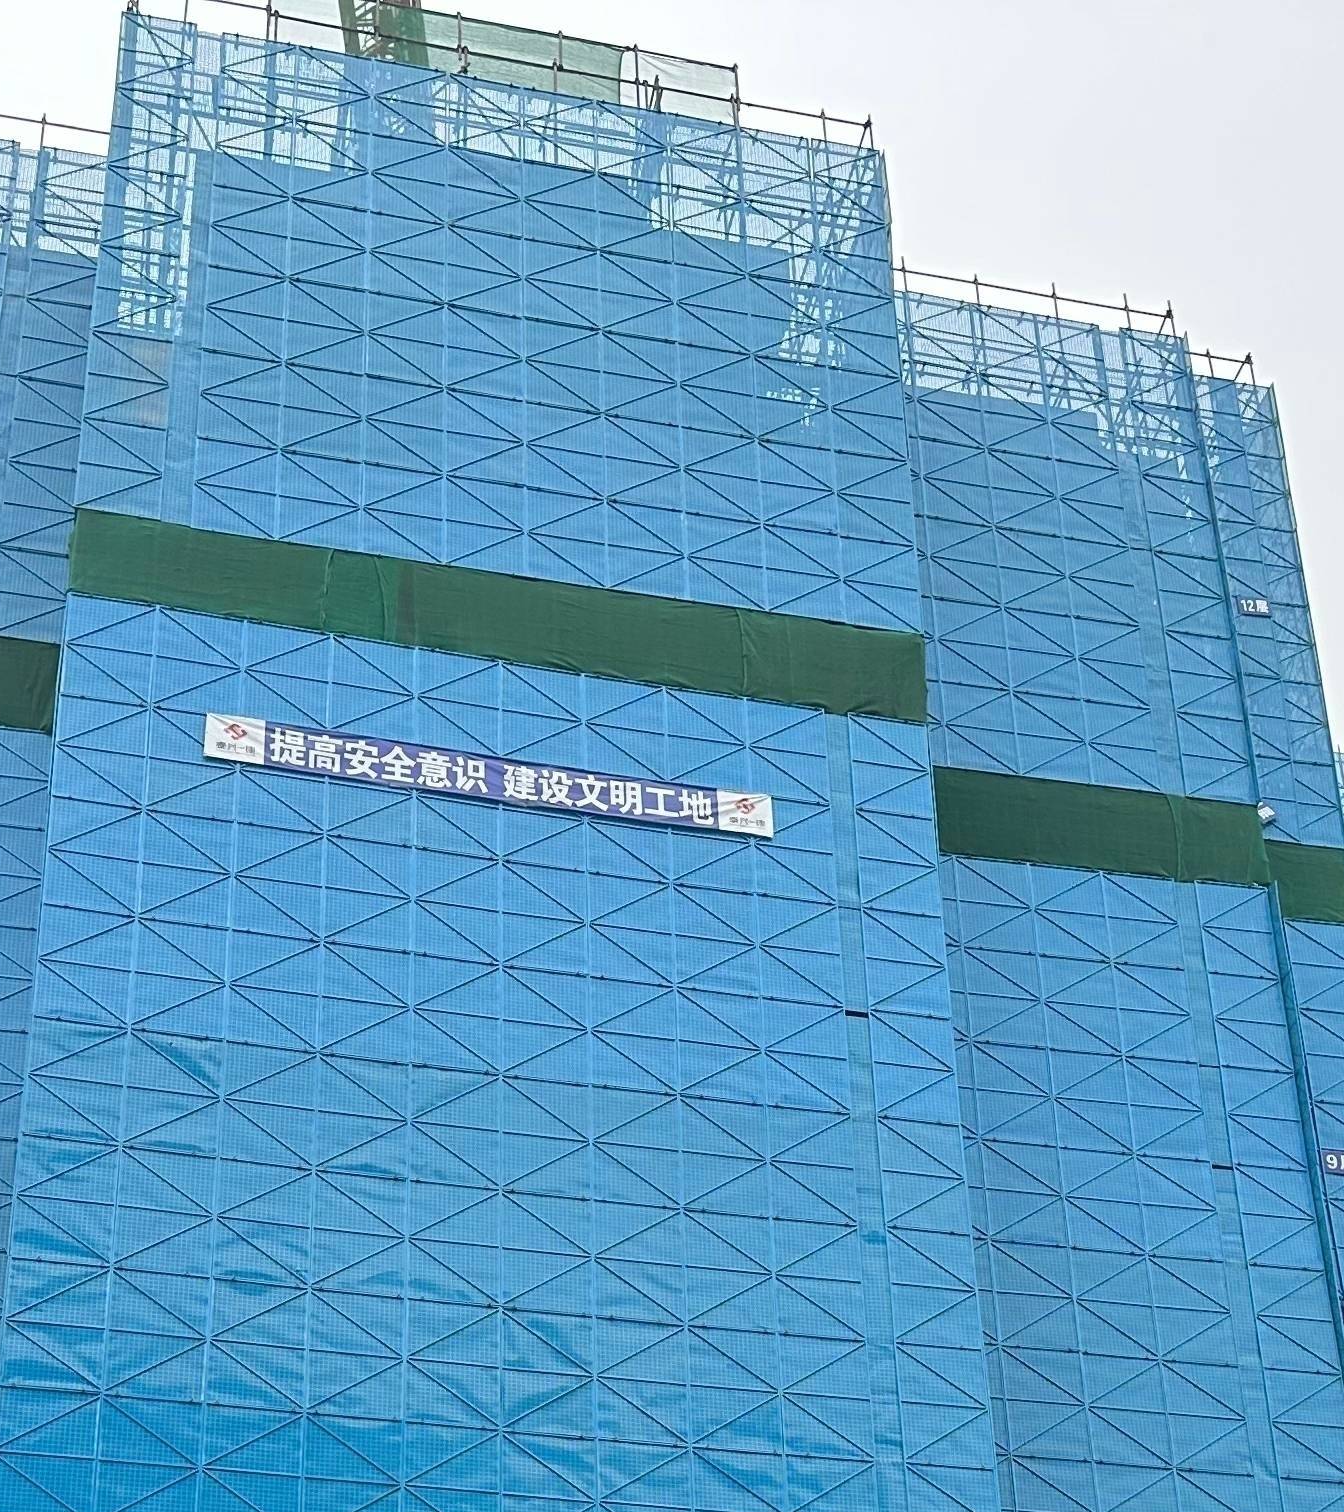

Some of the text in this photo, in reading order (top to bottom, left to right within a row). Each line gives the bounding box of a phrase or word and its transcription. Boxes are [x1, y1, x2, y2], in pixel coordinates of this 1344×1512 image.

[1240, 599, 1269, 613] 12层
[269, 727, 715, 825] 提高安全意识 建设文明工地
